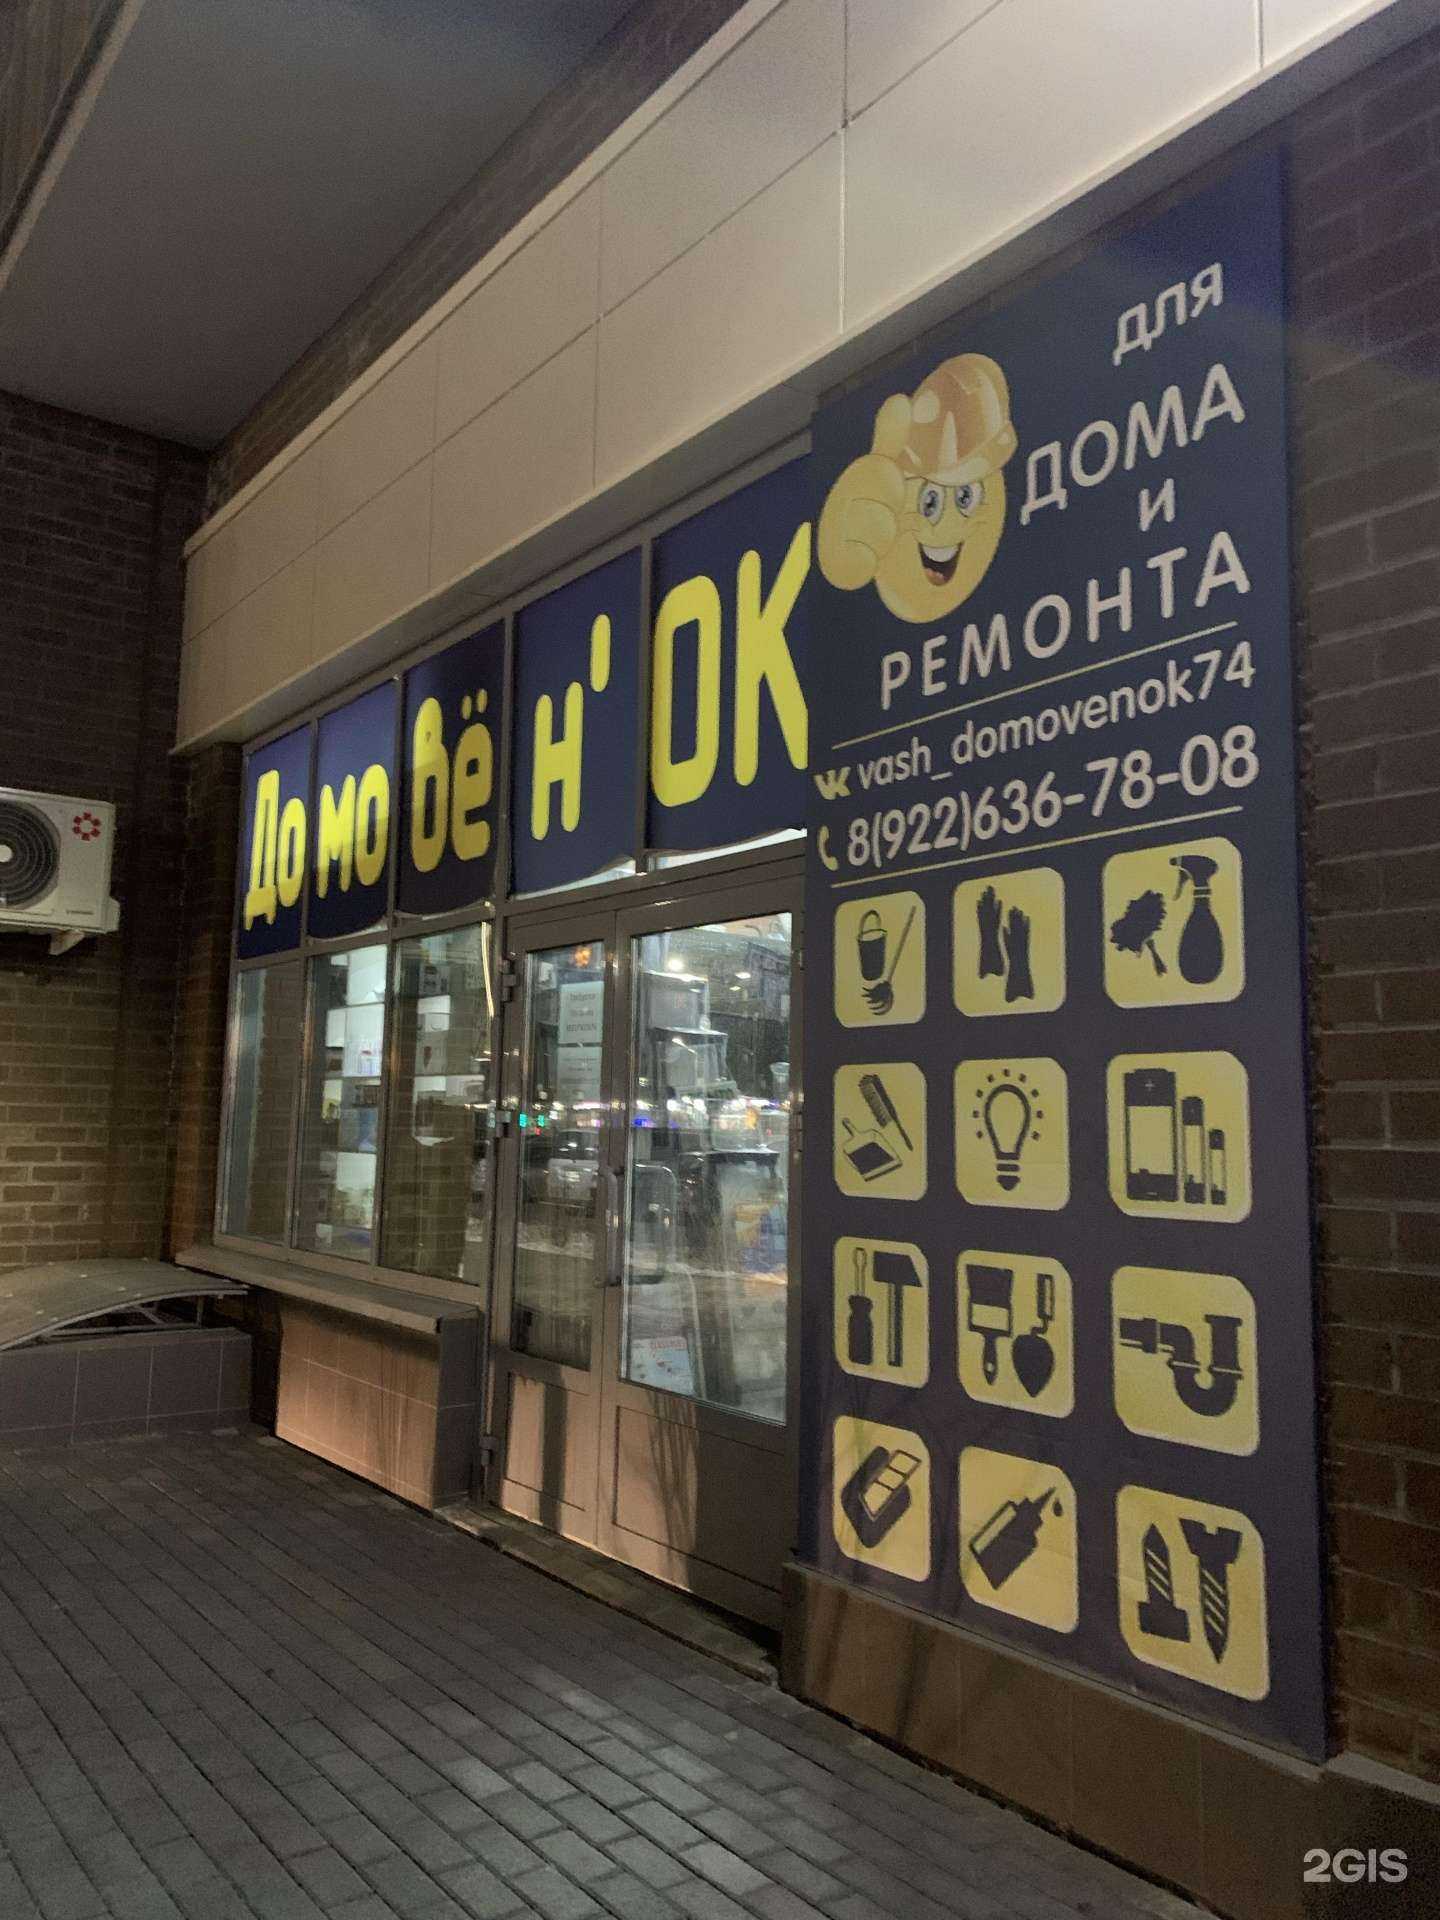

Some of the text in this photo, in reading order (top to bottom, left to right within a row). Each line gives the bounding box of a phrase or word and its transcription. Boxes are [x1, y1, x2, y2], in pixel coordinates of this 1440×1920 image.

[1020, 363, 1245, 525] ДОМА
[881, 531, 1251, 710] РЕМОНТА
[857, 641, 1255, 790] vash_domovenok74
[847, 725, 1260, 868] 8(922)636-78-08
